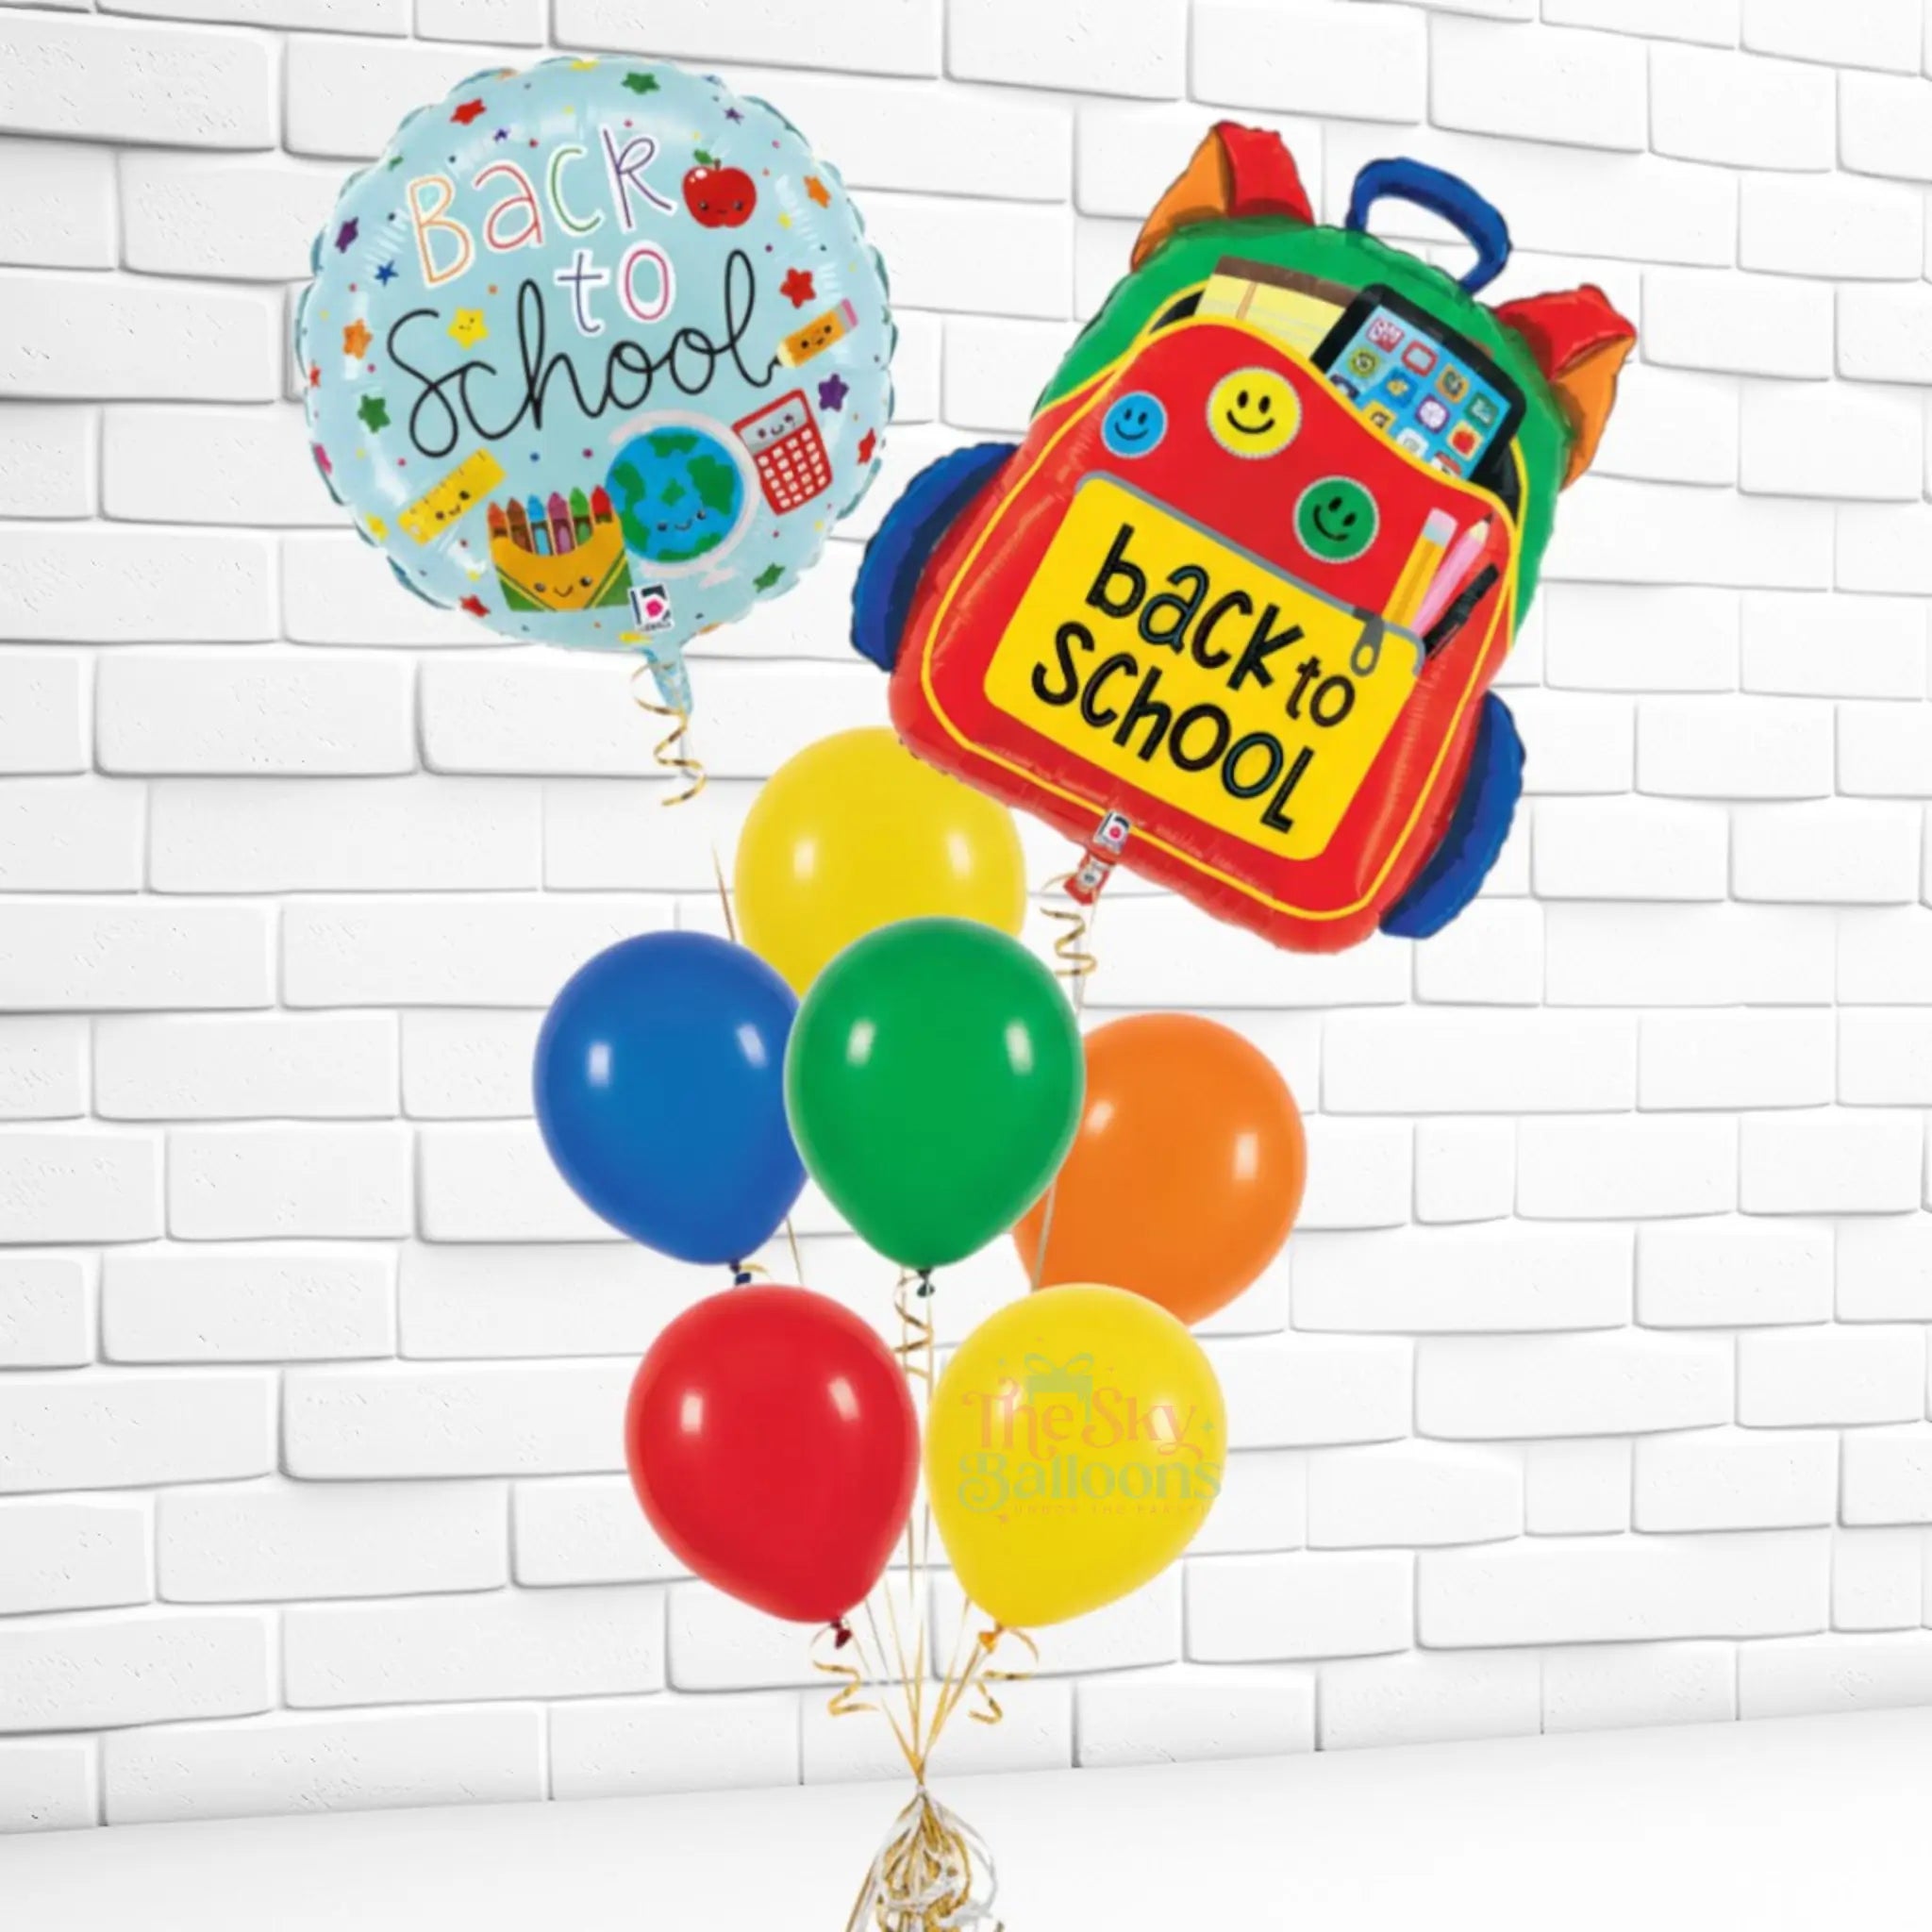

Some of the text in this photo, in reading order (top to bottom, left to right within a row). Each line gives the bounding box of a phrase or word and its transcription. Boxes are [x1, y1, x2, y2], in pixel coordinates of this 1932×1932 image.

[387, 249, 781, 458] School
[556, 245, 674, 335] to
[1086, 523, 1357, 728] back to
